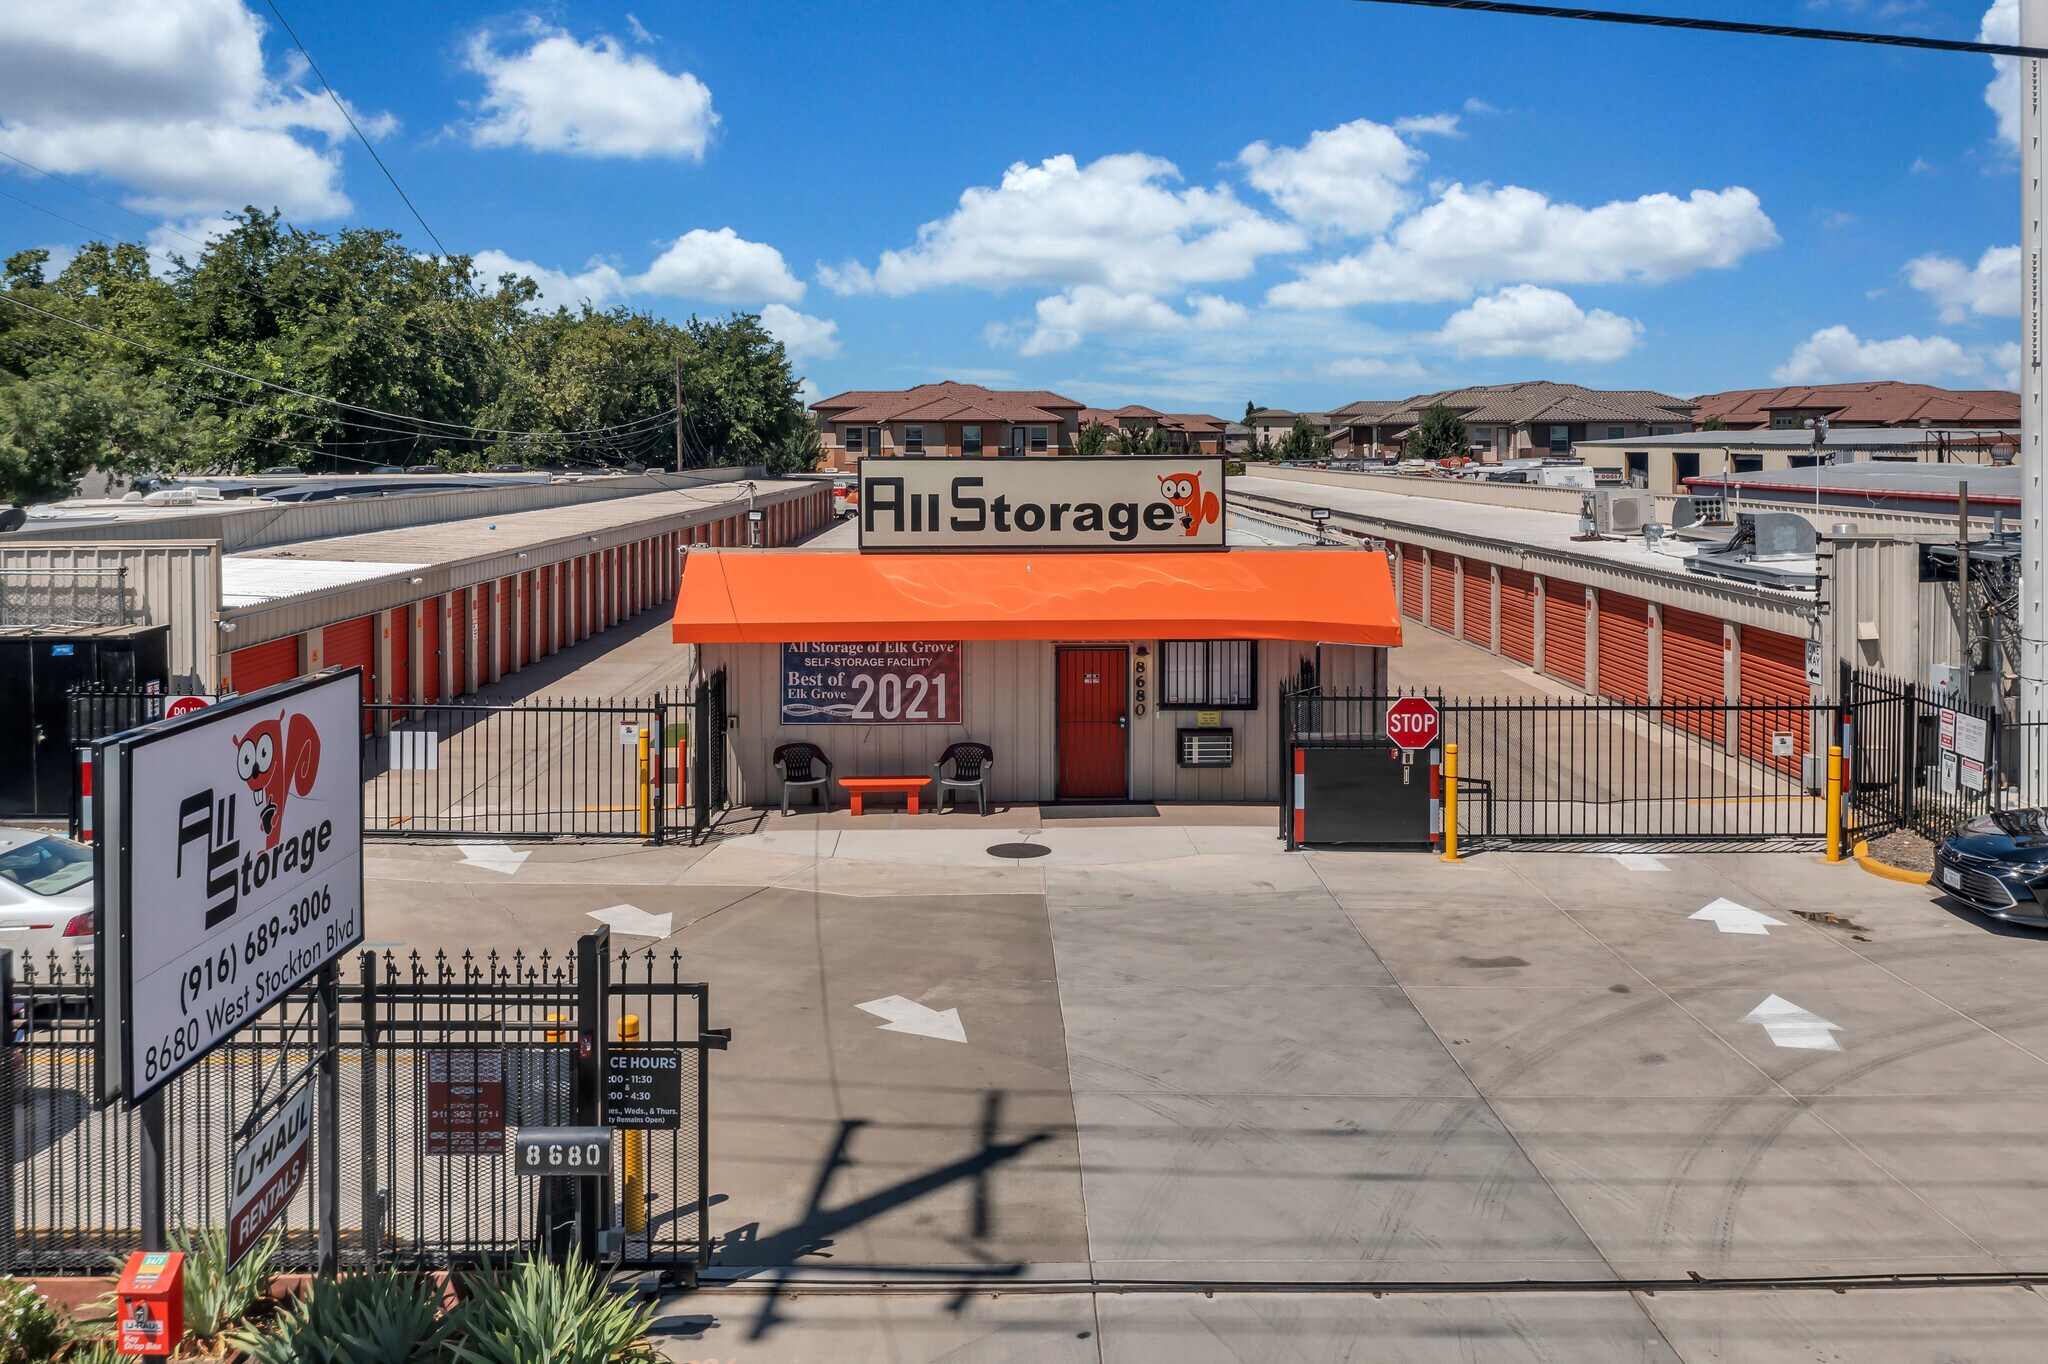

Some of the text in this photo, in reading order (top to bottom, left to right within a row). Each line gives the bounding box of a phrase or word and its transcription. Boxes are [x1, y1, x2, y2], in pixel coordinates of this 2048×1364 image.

[865, 477, 1175, 541] All Storage
[788, 642, 954, 655] All Storage of Elk Grove
[804, 658, 933, 667] SELF-STORAGE FACILITY
[787, 671, 846, 687] Best of
[787, 688, 847, 699] Elk Grove
[851, 673, 946, 719] 2021
[1135, 661, 1146, 716] 8680
[174, 706, 187, 716] DO
[1390, 713, 1435, 732] STOP
[176, 787, 236, 878] All
[205, 819, 332, 931] Storage
[180, 884, 331, 1016] (916) 689-3006
[145, 908, 354, 1082] 8680 West Stockton Blvd
[610, 1057, 677, 1069] CE HOURS
[631, 1075, 653, 1083] 11:30
[630, 1092, 651, 1100] 4:30
[624, 1107, 648, 1115] Weds.,
[649, 1107, 655, 1115] &
[656, 1107, 678, 1115] Thurs.
[645, 1116, 665, 1124] Open)
[236, 1101, 308, 1197] U-HAUL
[525, 1144, 600, 1166] 8680
[238, 1159, 299, 1246] RENTALS
[123, 1334, 140, 1344] Key
[123, 1341, 162, 1351] Drop Box
